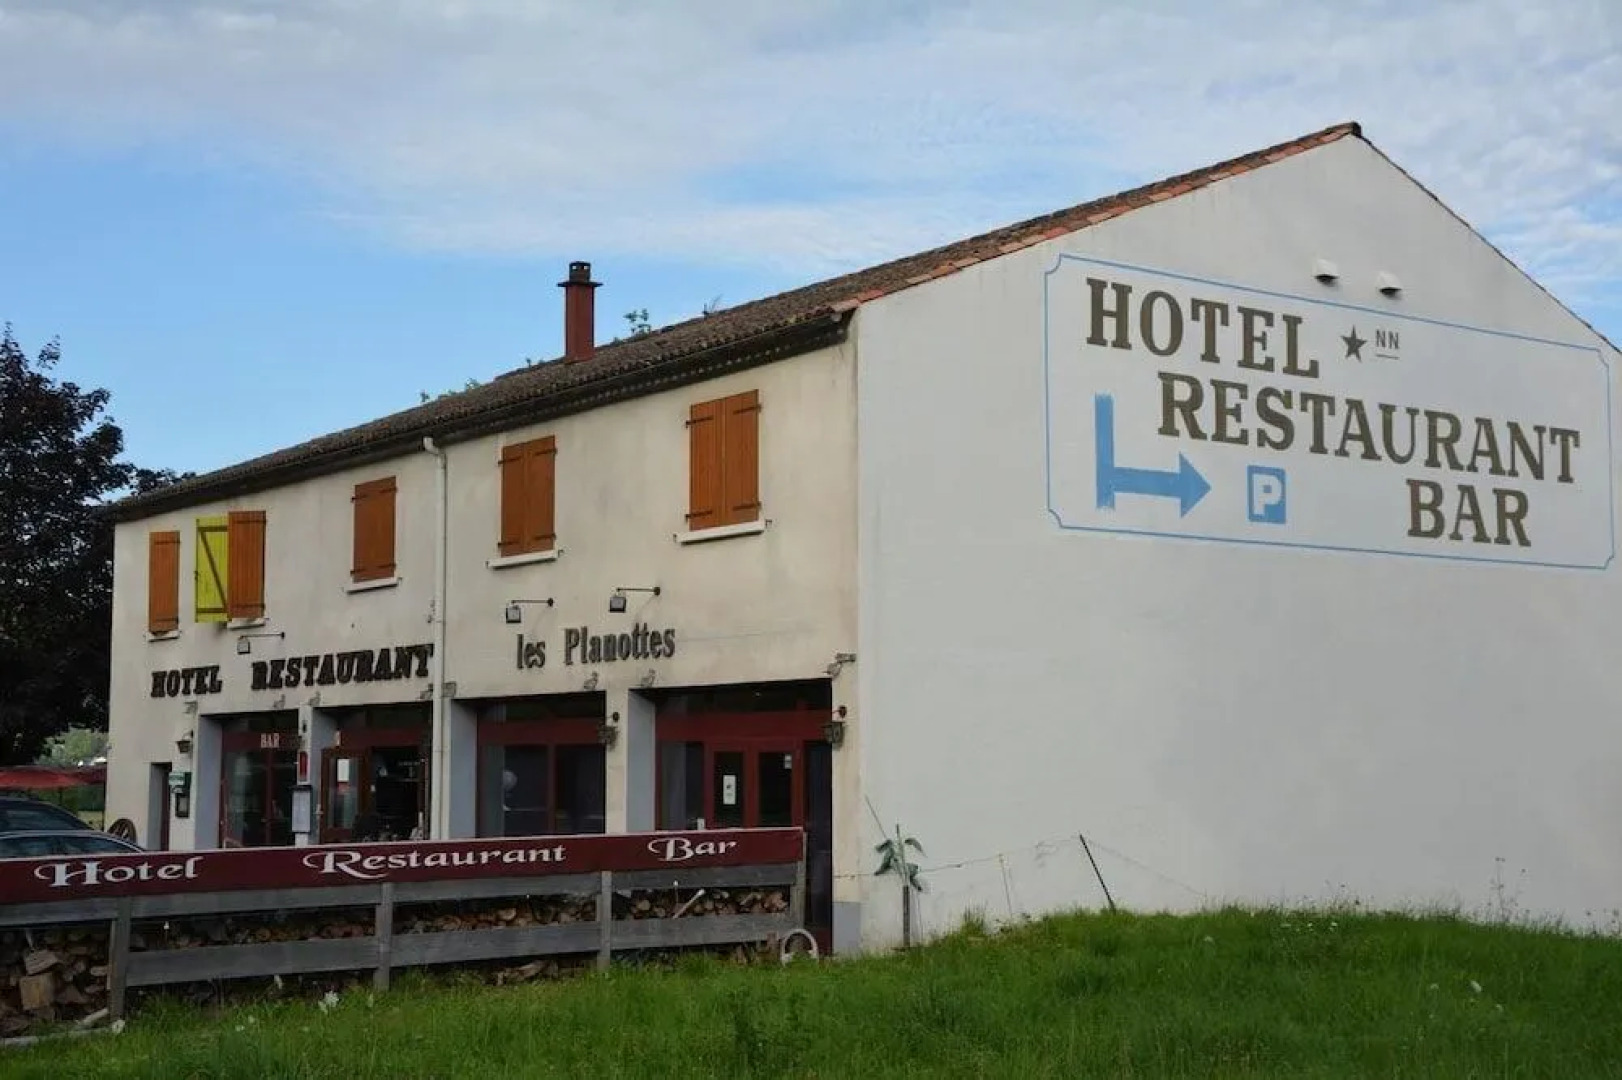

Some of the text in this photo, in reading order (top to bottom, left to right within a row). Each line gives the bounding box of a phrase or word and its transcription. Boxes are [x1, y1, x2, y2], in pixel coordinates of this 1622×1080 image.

[1086, 277, 1399, 379] HOTEL NN
[1157, 371, 1581, 484] RESTAURANT
[1253, 473, 1283, 517] P
[1406, 478, 1532, 548] BAR
[151, 643, 434, 698] HOTEL RESTAURANT
[517, 622, 676, 669] les Planottes
[261, 732, 280, 748] BAR
[34, 835, 739, 888] Hotel Restaurant Bar
